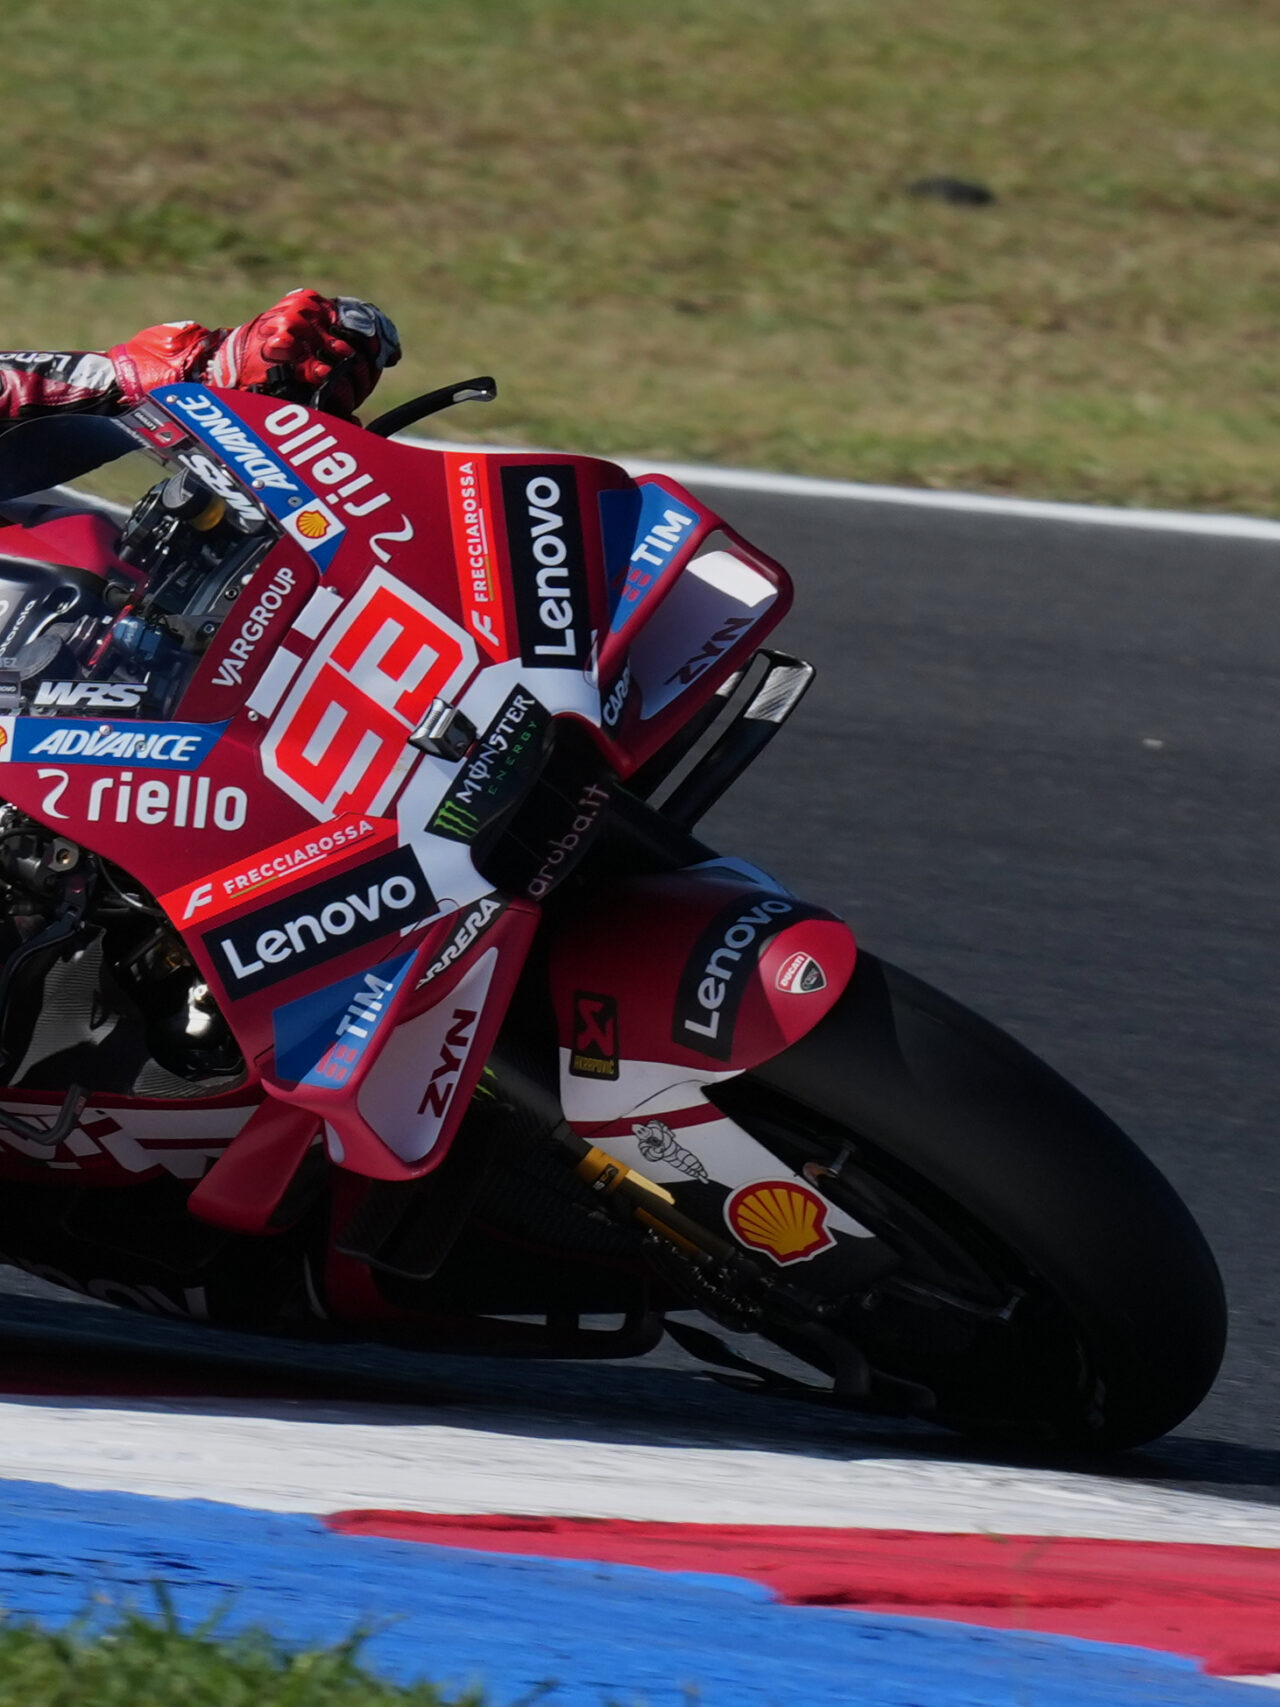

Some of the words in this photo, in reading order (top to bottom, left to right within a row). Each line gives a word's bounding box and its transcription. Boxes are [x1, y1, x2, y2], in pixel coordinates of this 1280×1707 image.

[176, 394, 299, 491] ADVANCE
[178, 454, 266, 521] WRS
[264, 404, 392, 517] riello
[459, 461, 490, 603] FRECCIAROSSA
[526, 476, 576, 656] Lenovo
[631, 510, 693, 567] TIM
[211, 566, 297, 686] VARGROUP
[663, 618, 756, 685] ZYN
[33, 681, 148, 708] WRS
[274, 585, 464, 816] 93
[29, 728, 202, 762] ADVANCE
[456, 694, 535, 803] MONSTER
[488, 720, 537, 795] ENERGY
[87, 771, 248, 831] riello
[528, 783, 610, 896] aruba.it
[223, 820, 373, 894] FRECCIAROSSA
[221, 875, 416, 980] Lenovo
[684, 900, 792, 1039] Lenovo
[780, 955, 805, 987] DUCATI
[335, 973, 393, 1038] TIM
[417, 1009, 477, 1118] ZYN
